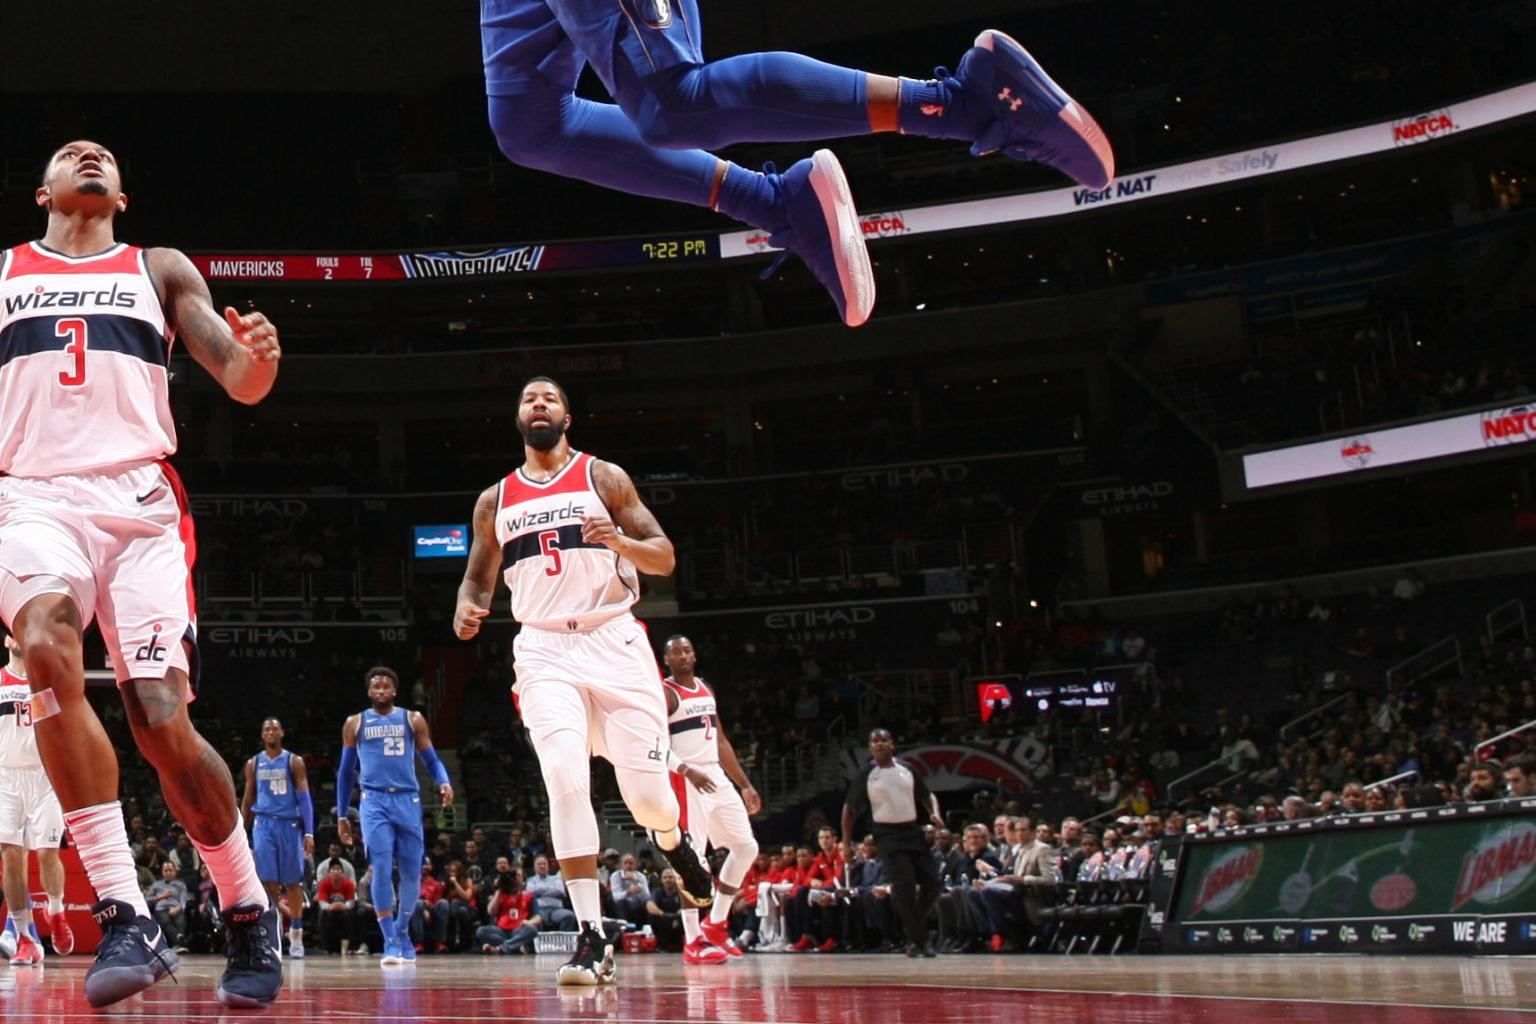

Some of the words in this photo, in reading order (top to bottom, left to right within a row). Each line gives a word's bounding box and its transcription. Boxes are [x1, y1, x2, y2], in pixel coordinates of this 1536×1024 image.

[1394, 115, 1454, 141] NATCA
[1217, 150, 1279, 175] Safely
[1116, 176, 1157, 197] NAT
[863, 218, 902, 236] ATCA
[642, 241, 679, 258] 7:22
[684, 240, 706, 256] PM
[210, 259, 285, 278] MAVERICKS
[316, 257, 339, 268] FOULS
[324, 268, 333, 280] 2
[364, 268, 372, 279] 7
[4, 282, 137, 316] wizards
[55, 317, 86, 387] 3
[1484, 411, 1536, 440] NATC
[841, 465, 968, 490] ETIHAD
[1081, 480, 1173, 504] ETIHAD
[192, 498, 307, 516] ETIHAD
[506, 500, 586, 533] wizards
[538, 530, 562, 577] 5
[765, 606, 877, 630] ETIHAD
[949, 600, 980, 615] 104
[208, 628, 315, 644] ETIHAD
[379, 629, 408, 642] 105
[228, 648, 297, 659] AIRWAYS
[13, 702, 33, 727] 13
[700, 715, 713, 741] 2
[383, 736, 405, 756] 23
[269, 779, 287, 796] 40
[1452, 921, 1475, 942] WE
[1476, 922, 1506, 943] ARE
